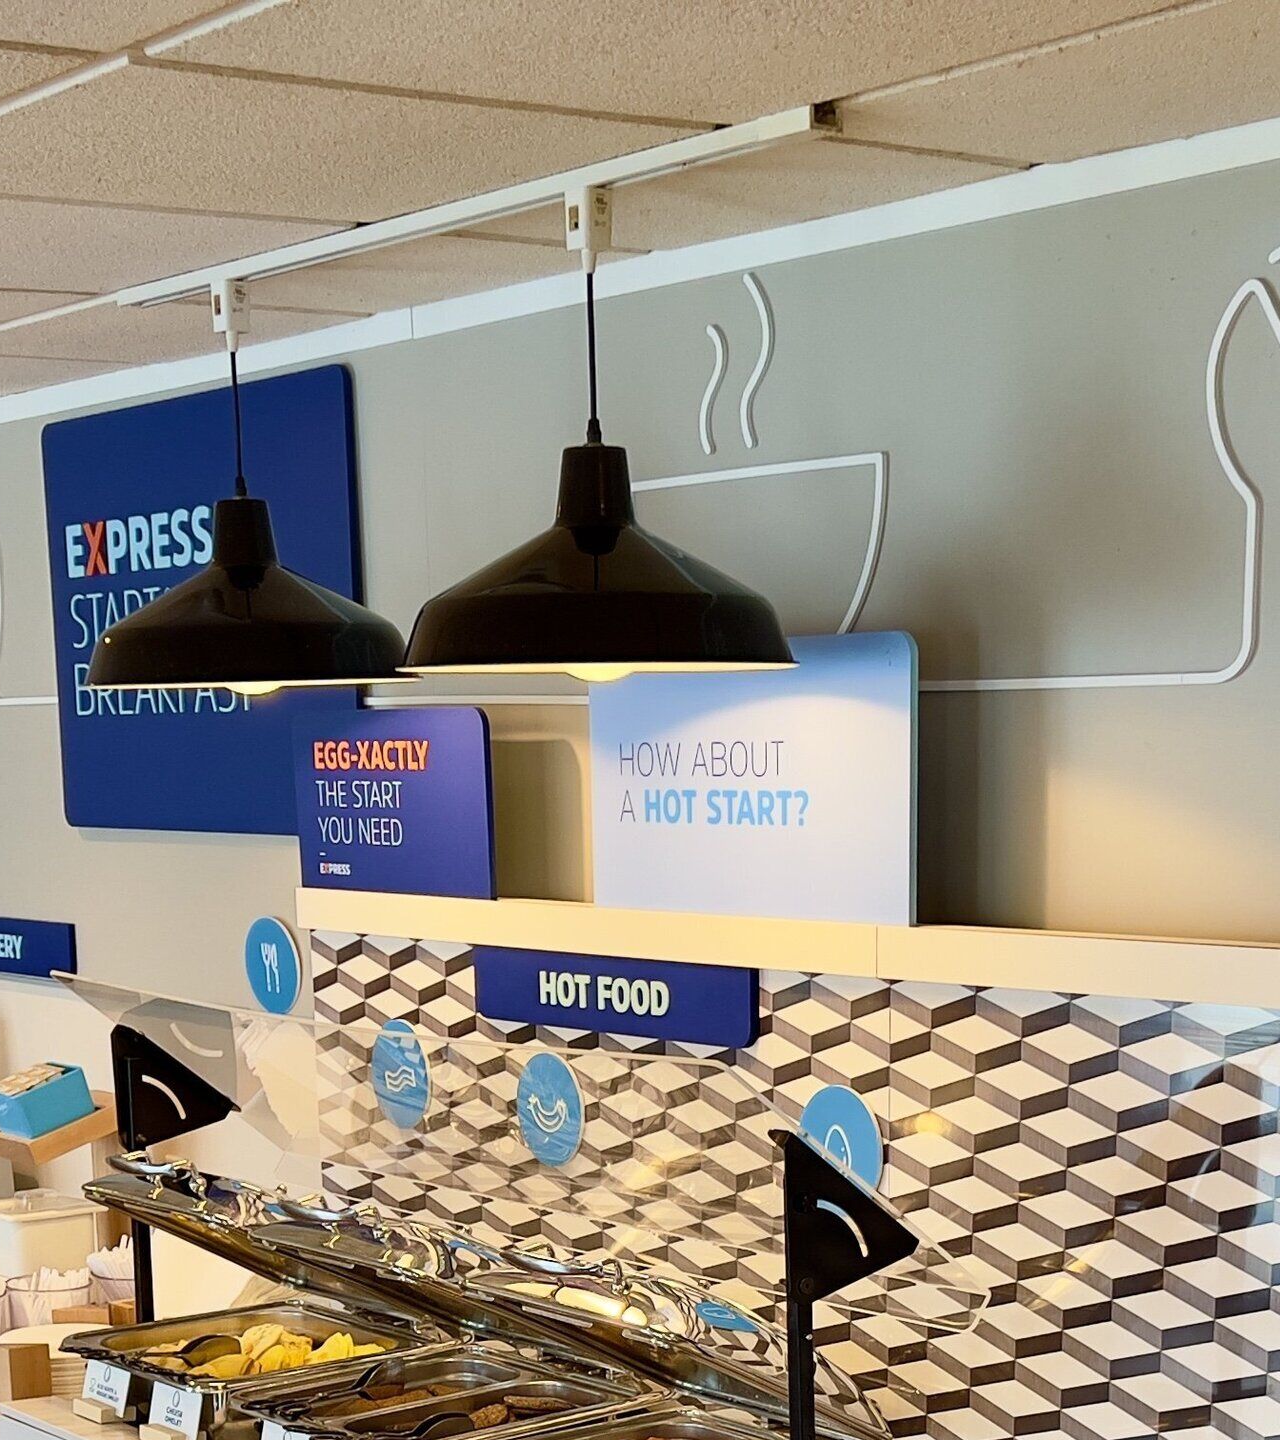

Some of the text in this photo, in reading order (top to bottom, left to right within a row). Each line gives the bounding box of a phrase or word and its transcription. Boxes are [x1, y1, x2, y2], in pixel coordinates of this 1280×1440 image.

[65, 504, 213, 578] EXPRESS
[313, 740, 430, 771] EGG-XACTLY
[619, 740, 784, 777] HOW ABOUT
[316, 780, 402, 809] THE START
[620, 788, 810, 827] A HOT START?
[318, 816, 403, 846] YOU NEED
[319, 862, 351, 876] EXPRESS
[538, 969, 670, 1017] HOT FOOD
